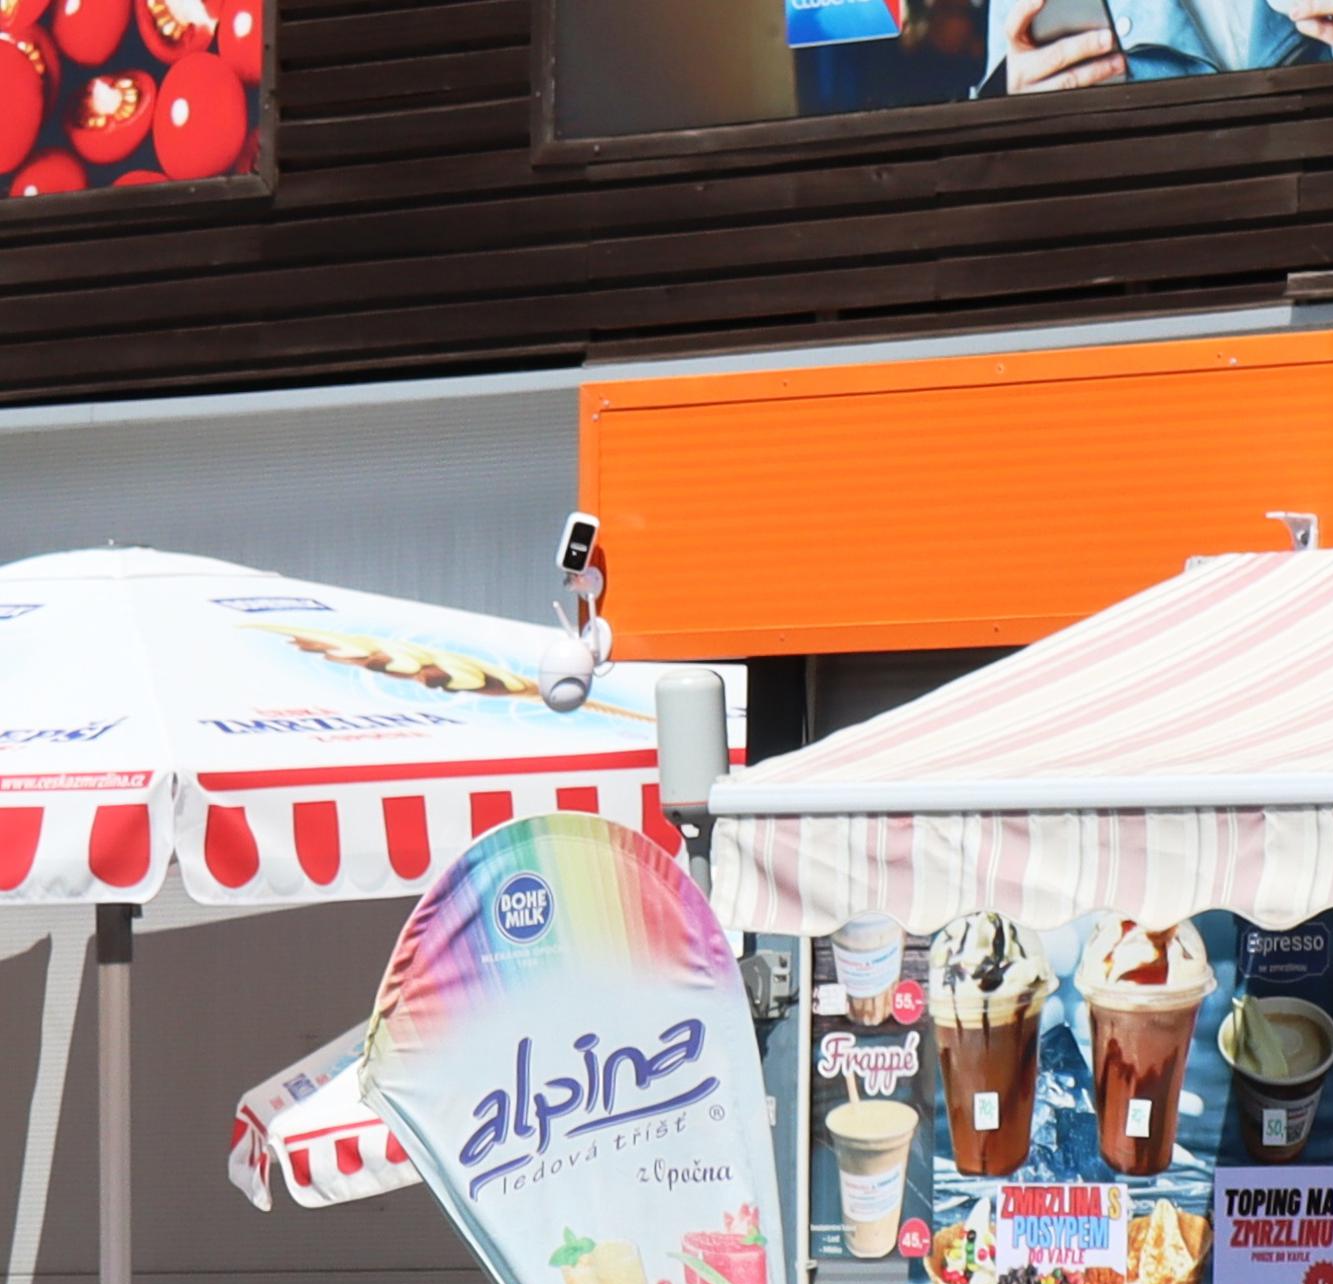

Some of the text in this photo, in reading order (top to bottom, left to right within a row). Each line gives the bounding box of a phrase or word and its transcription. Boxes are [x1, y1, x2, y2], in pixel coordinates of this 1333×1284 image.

[500, 888, 548, 913] BOHE
[505, 906, 545, 929] MILK
[1247, 932, 1325, 957] Espresso
[819, 1031, 920, 1095] Frappé
[459, 1018, 706, 1166] alpina
[501, 1112, 687, 1195] ledová tříšť
[1001, 1186, 1121, 1220] ZMRZLINA S
[1225, 1188, 1302, 1218] TOPING
[1012, 1216, 1110, 1250] POSYPEM
[1028, 1248, 1086, 1265] DO VAFLE
